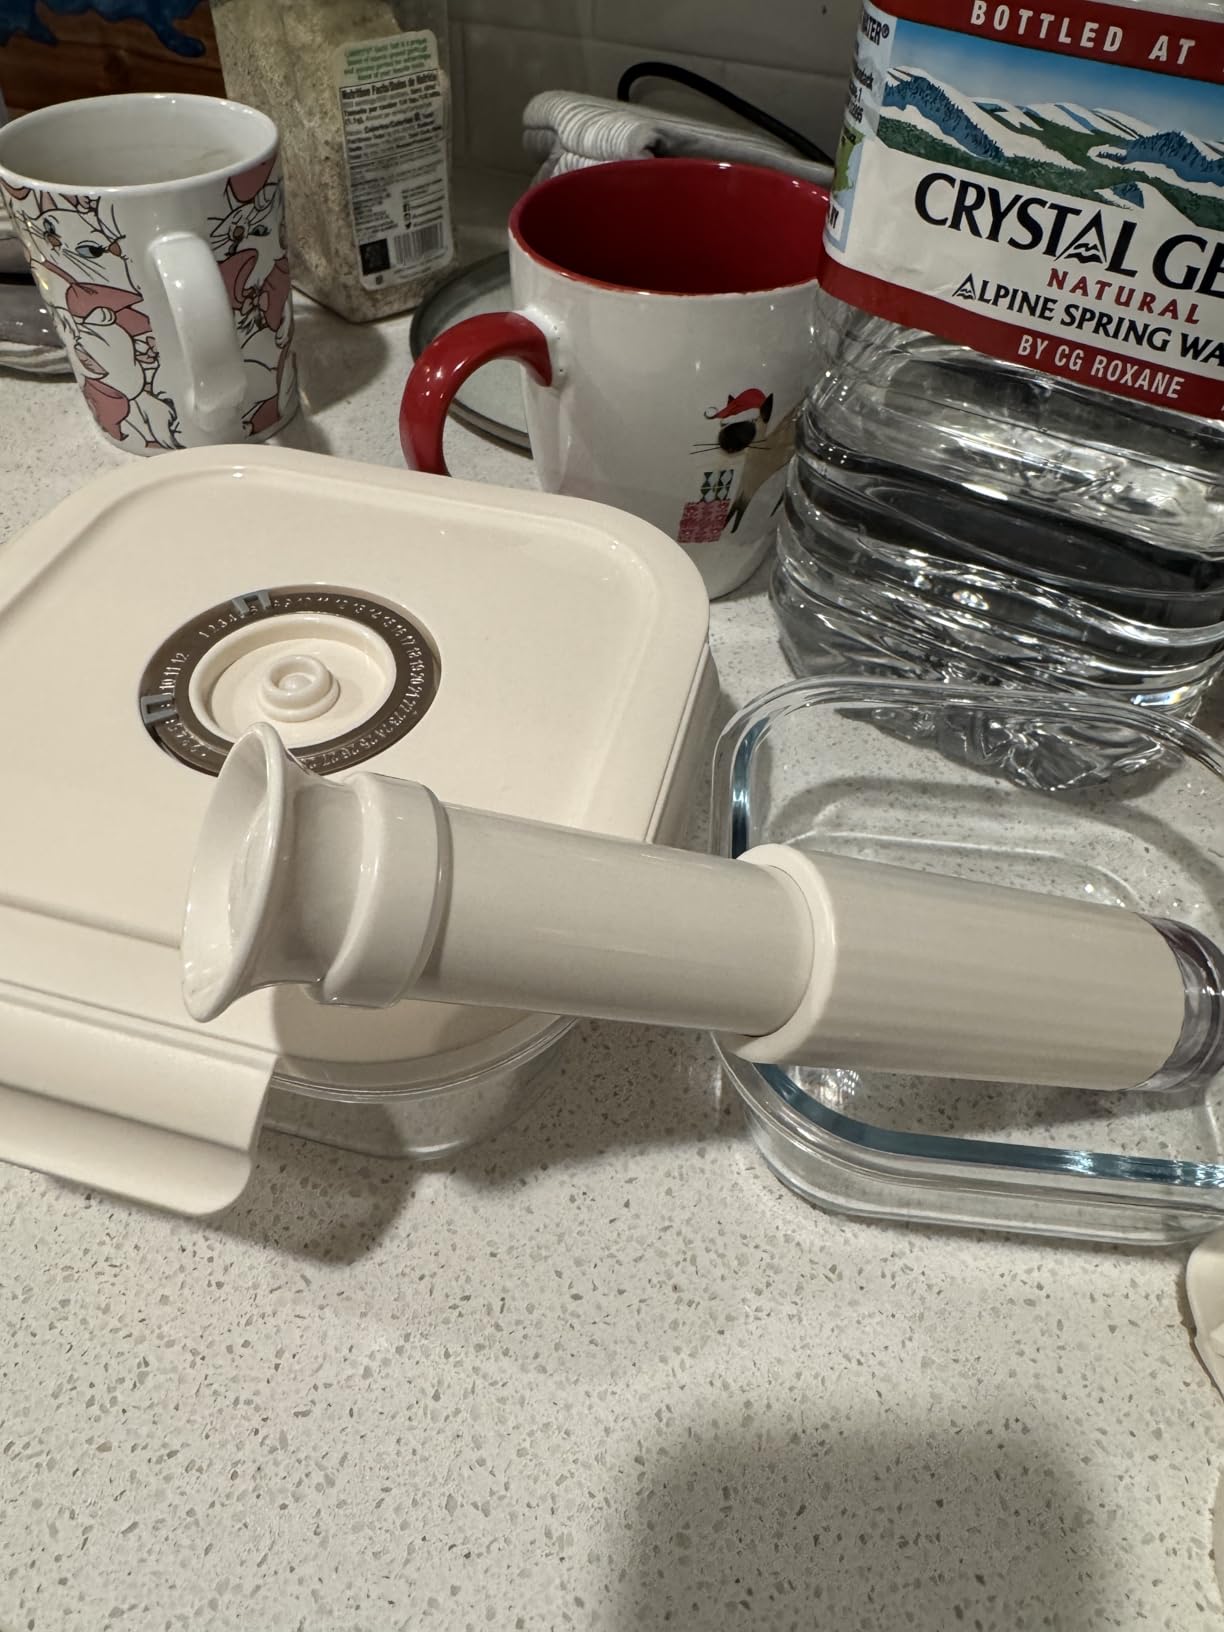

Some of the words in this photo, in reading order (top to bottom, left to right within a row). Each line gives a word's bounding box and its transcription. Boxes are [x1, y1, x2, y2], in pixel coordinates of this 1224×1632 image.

[970, 0, 1123, 53] BOTTLED
[1149, 35, 1196, 65] AT
[914, 172, 1138, 278] CRYSTAL
[951, 273, 1059, 321] ALPINE
[1059, 303, 1173, 353] SPRING
[1046, 268, 1200, 325] NATURAL
[1017, 334, 1049, 360] BY
[1054, 345, 1084, 372] CG
[1090, 355, 1185, 399] ROXANE
